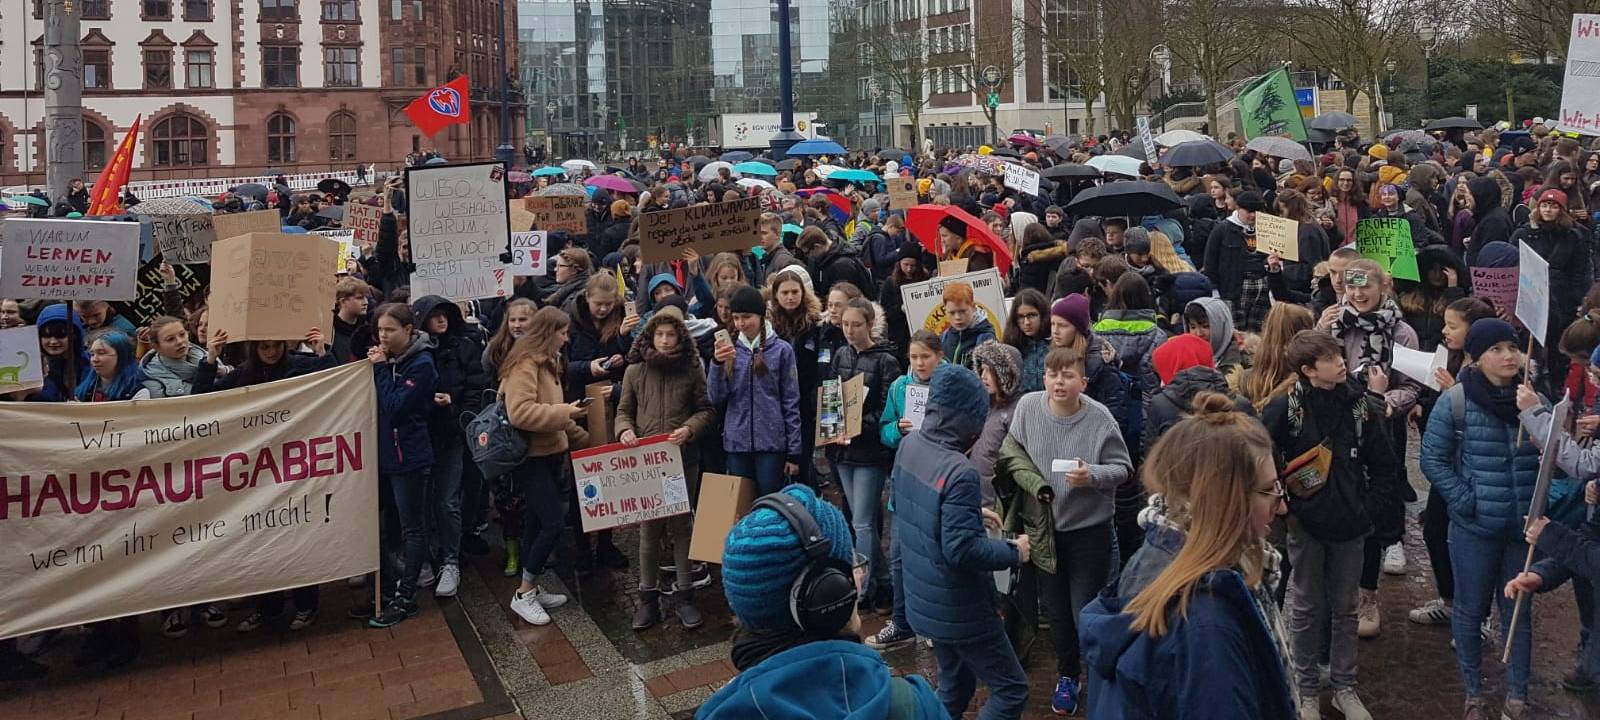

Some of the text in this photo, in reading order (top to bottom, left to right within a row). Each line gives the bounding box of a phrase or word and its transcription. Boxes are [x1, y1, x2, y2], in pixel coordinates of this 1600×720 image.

[1577, 18, 1600, 38] Wi
[1563, 109, 1591, 129] Wir
[350, 205, 368, 217] HAT
[646, 212, 673, 227] Der
[413, 219, 477, 235] WARUM
[30, 228, 90, 244] WARUM
[513, 233, 541, 248] NO
[1357, 236, 1392, 247] HEUTE
[27, 245, 112, 265] LERNEN
[415, 239, 496, 259] WER NOCH
[25, 263, 60, 273] WENN
[64, 264, 81, 273] WIR
[1473, 269, 1515, 280] Wollen
[21, 274, 115, 288] ZUKUNFT
[424, 276, 488, 298] DUMM
[910, 289, 922, 300] Für
[924, 287, 935, 298] ein
[972, 278, 993, 289] NRW!
[70, 406, 292, 450] Wir machen unsre
[582, 461, 604, 474] WIR
[610, 456, 637, 471] SIND
[0, 431, 363, 520] HAUSAUFGABEN
[600, 474, 617, 488] WIR
[620, 471, 641, 486] SIND
[584, 501, 618, 519] WEIL
[620, 497, 639, 513] IHR
[641, 492, 662, 511] UNS
[616, 514, 631, 527] DIE
[29, 543, 104, 571] wenn
[124, 521, 157, 557] ihr
[172, 516, 226, 546] eure
[241, 495, 312, 534] macht
